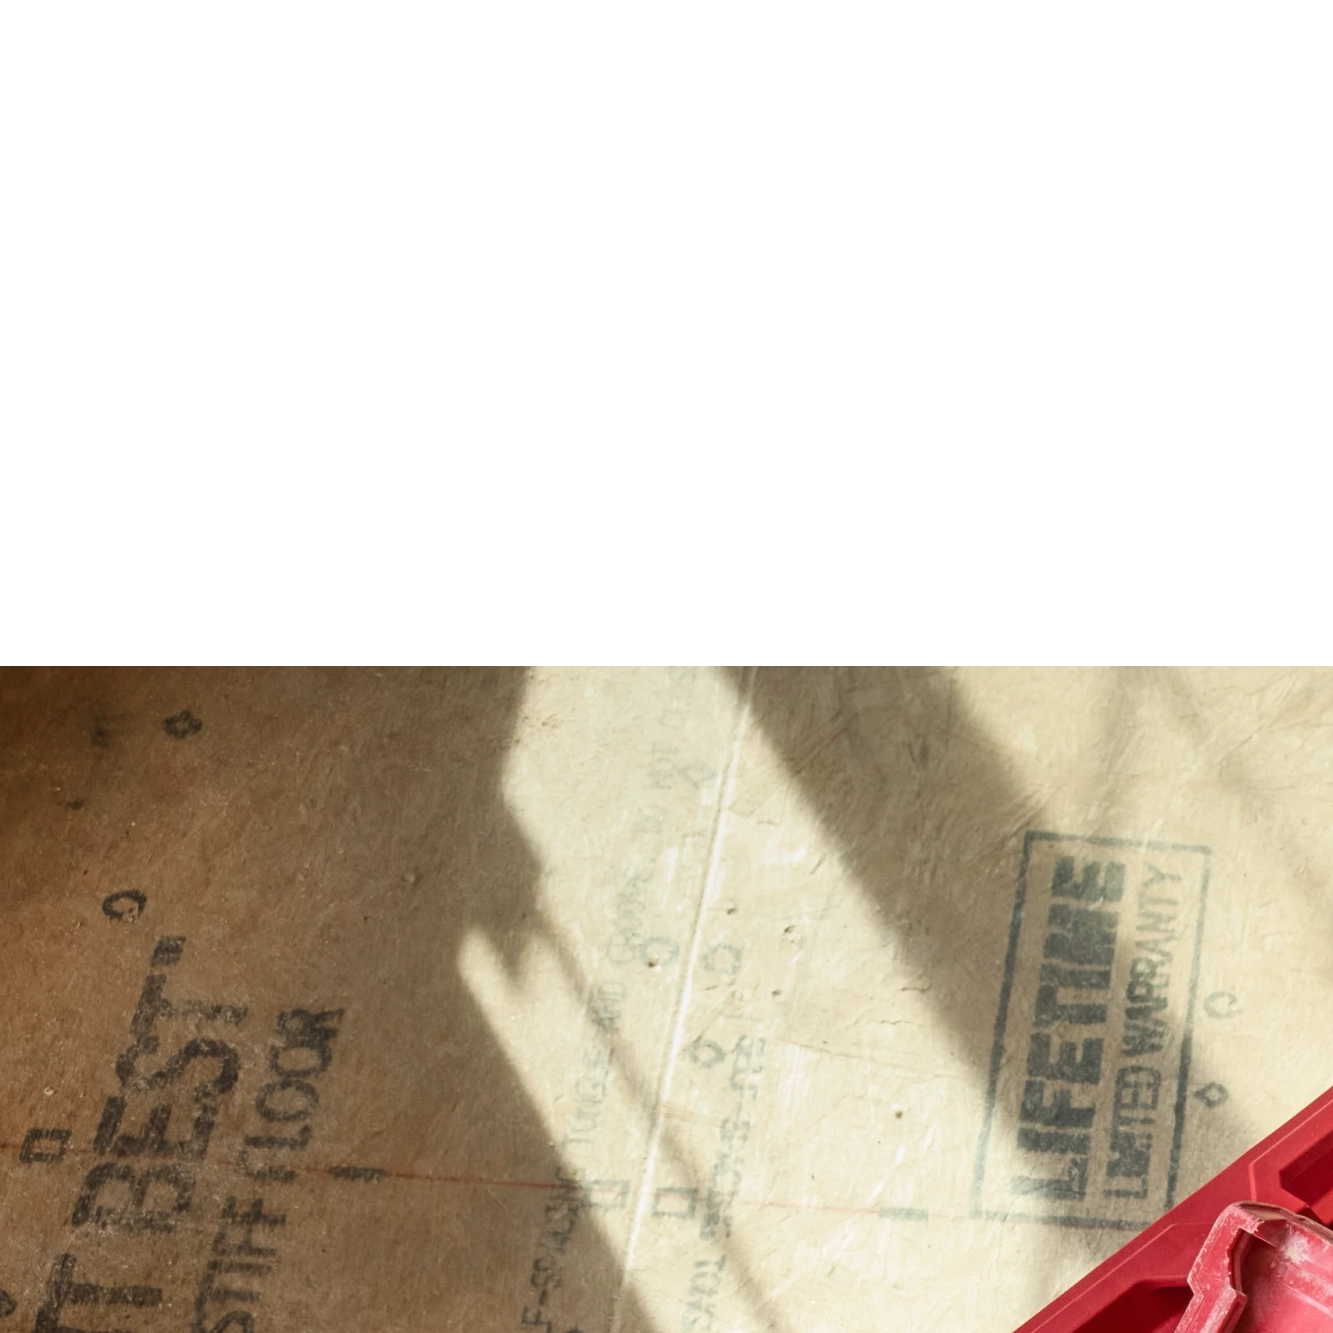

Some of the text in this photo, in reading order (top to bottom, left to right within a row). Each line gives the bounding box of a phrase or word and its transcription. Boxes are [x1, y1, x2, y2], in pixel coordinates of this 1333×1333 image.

[238, 1008, 344, 1184] FLOOR
[1010, 855, 1126, 1201] LIFETIME
[1107, 862, 1182, 1201] LIMITED WARRANTY
